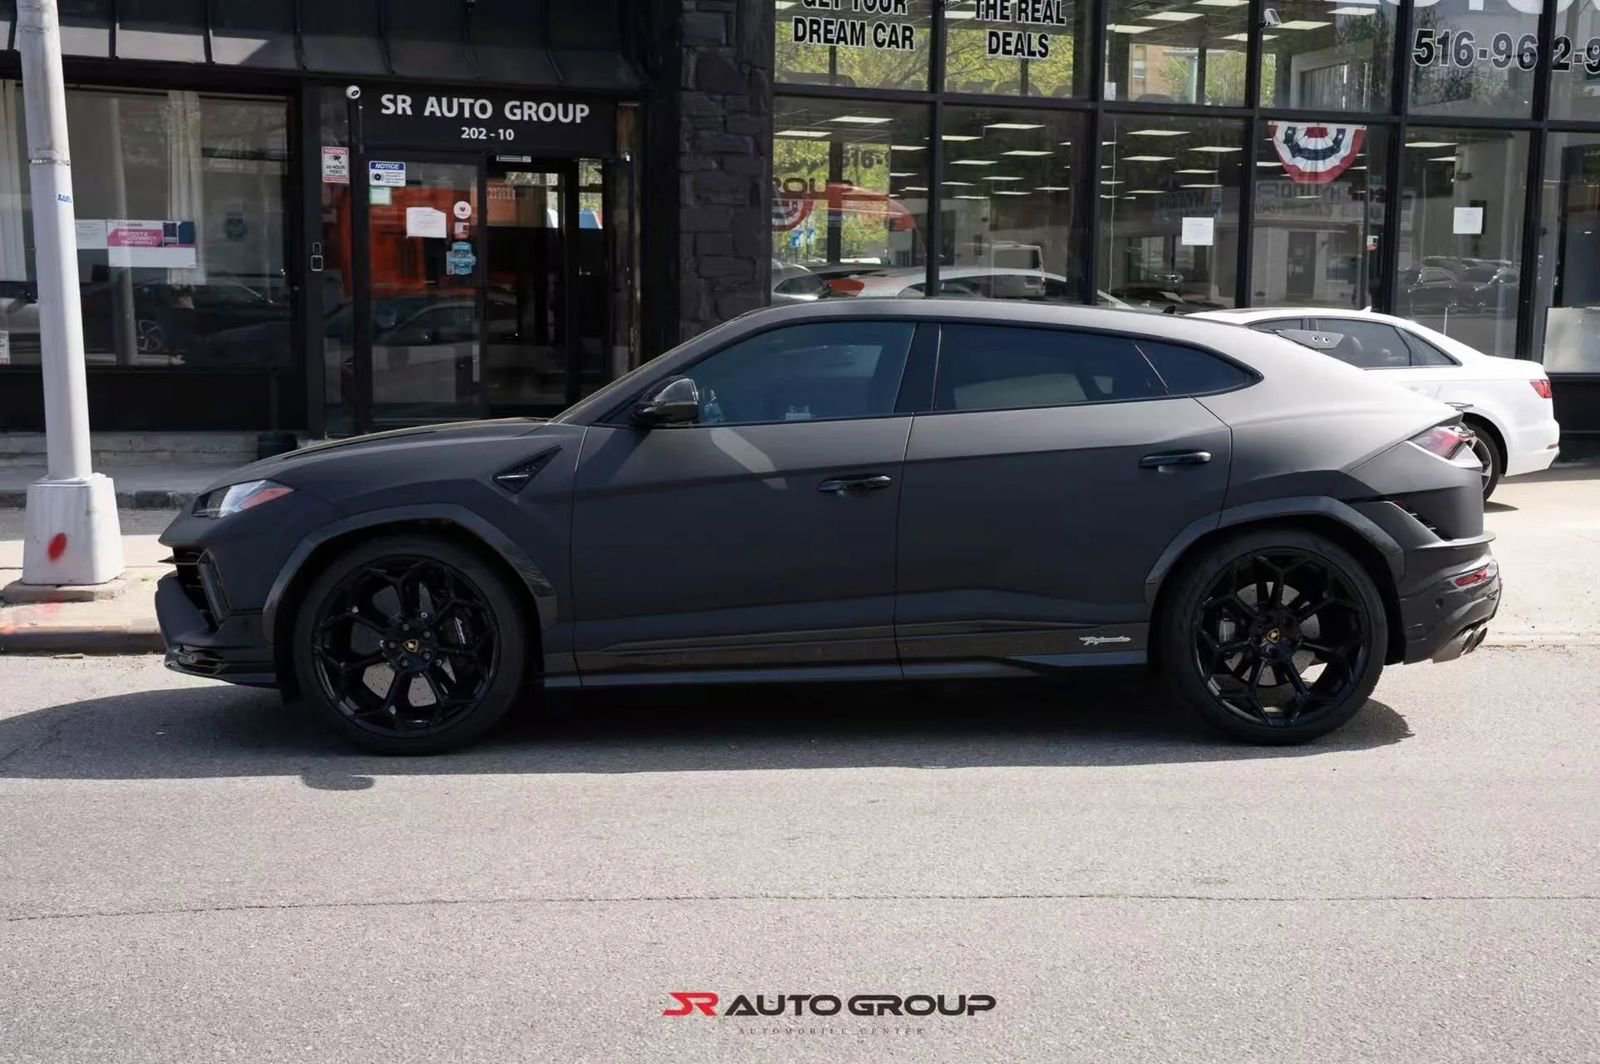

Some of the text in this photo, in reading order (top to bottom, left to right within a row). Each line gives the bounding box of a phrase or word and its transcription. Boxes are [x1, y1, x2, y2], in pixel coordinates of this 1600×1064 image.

[976, 0, 1067, 26] THE REAL
[793, 16, 915, 51] DREAM CAR
[987, 29, 1050, 59] DEALS
[380, 93, 590, 124] SR AUTO GROUP
